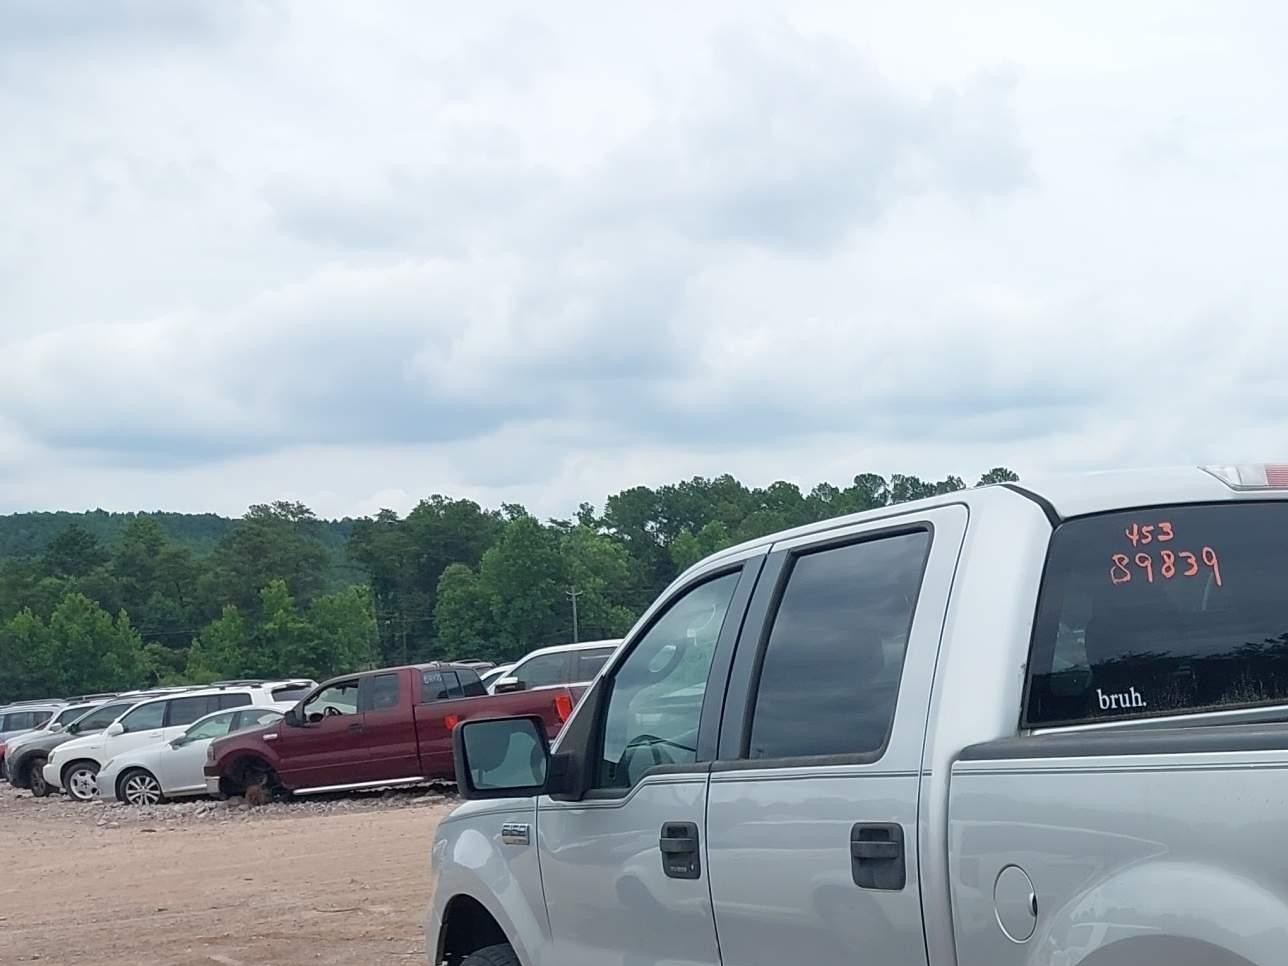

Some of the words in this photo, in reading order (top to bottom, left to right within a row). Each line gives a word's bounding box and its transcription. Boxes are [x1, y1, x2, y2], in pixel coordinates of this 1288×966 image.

[1125, 522, 1174, 547] 453
[1110, 546, 1222, 586] 89839
[1096, 686, 1147, 710] bruh.
